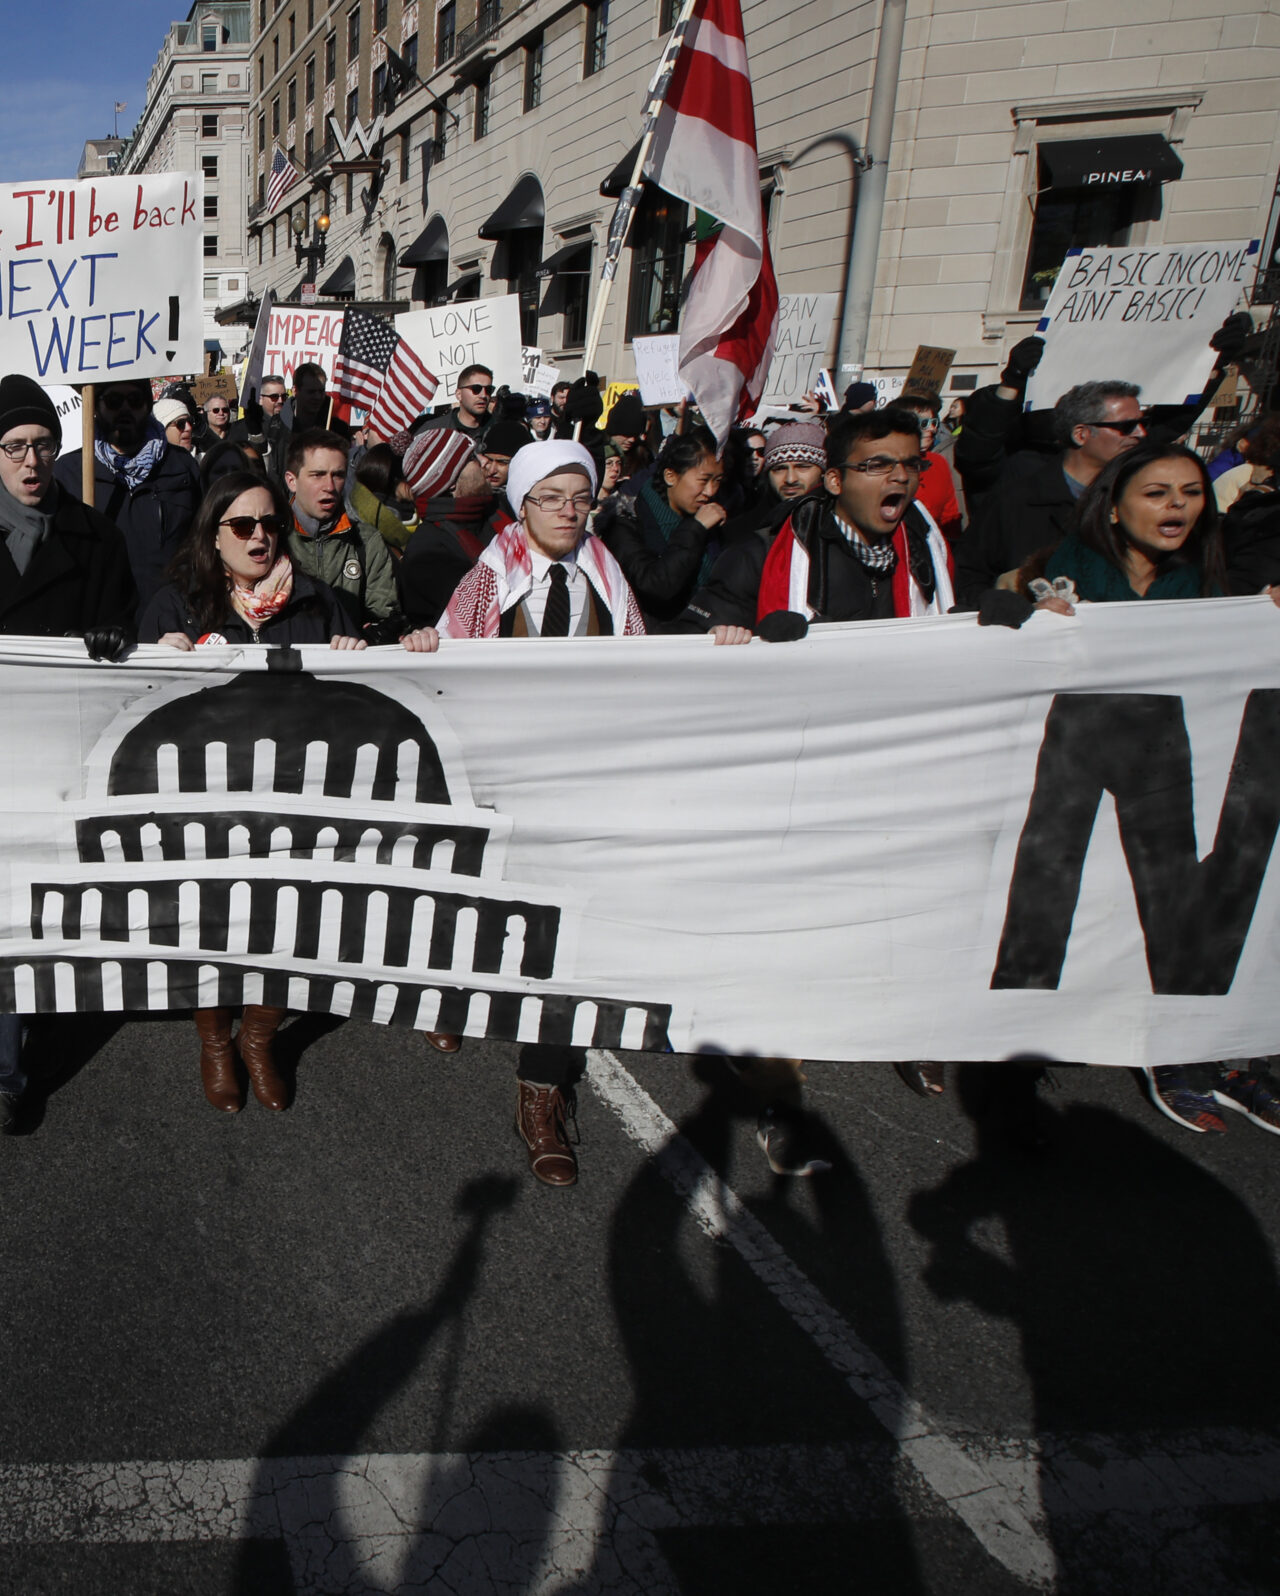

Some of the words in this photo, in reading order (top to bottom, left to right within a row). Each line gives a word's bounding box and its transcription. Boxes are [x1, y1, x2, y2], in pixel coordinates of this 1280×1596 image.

[329, 115, 384, 159] W
[1088, 169, 1147, 185] PINEA
[13, 189, 75, 251] I'll
[88, 186, 119, 237] be
[133, 180, 196, 230] back
[1067, 253, 1160, 289] BASIC
[1156, 249, 1248, 285] INCOME
[430, 305, 492, 338] LOVE
[1054, 290, 1122, 322] AINT
[1121, 287, 1207, 322] BASIC!
[439, 341, 480, 367] NOT
